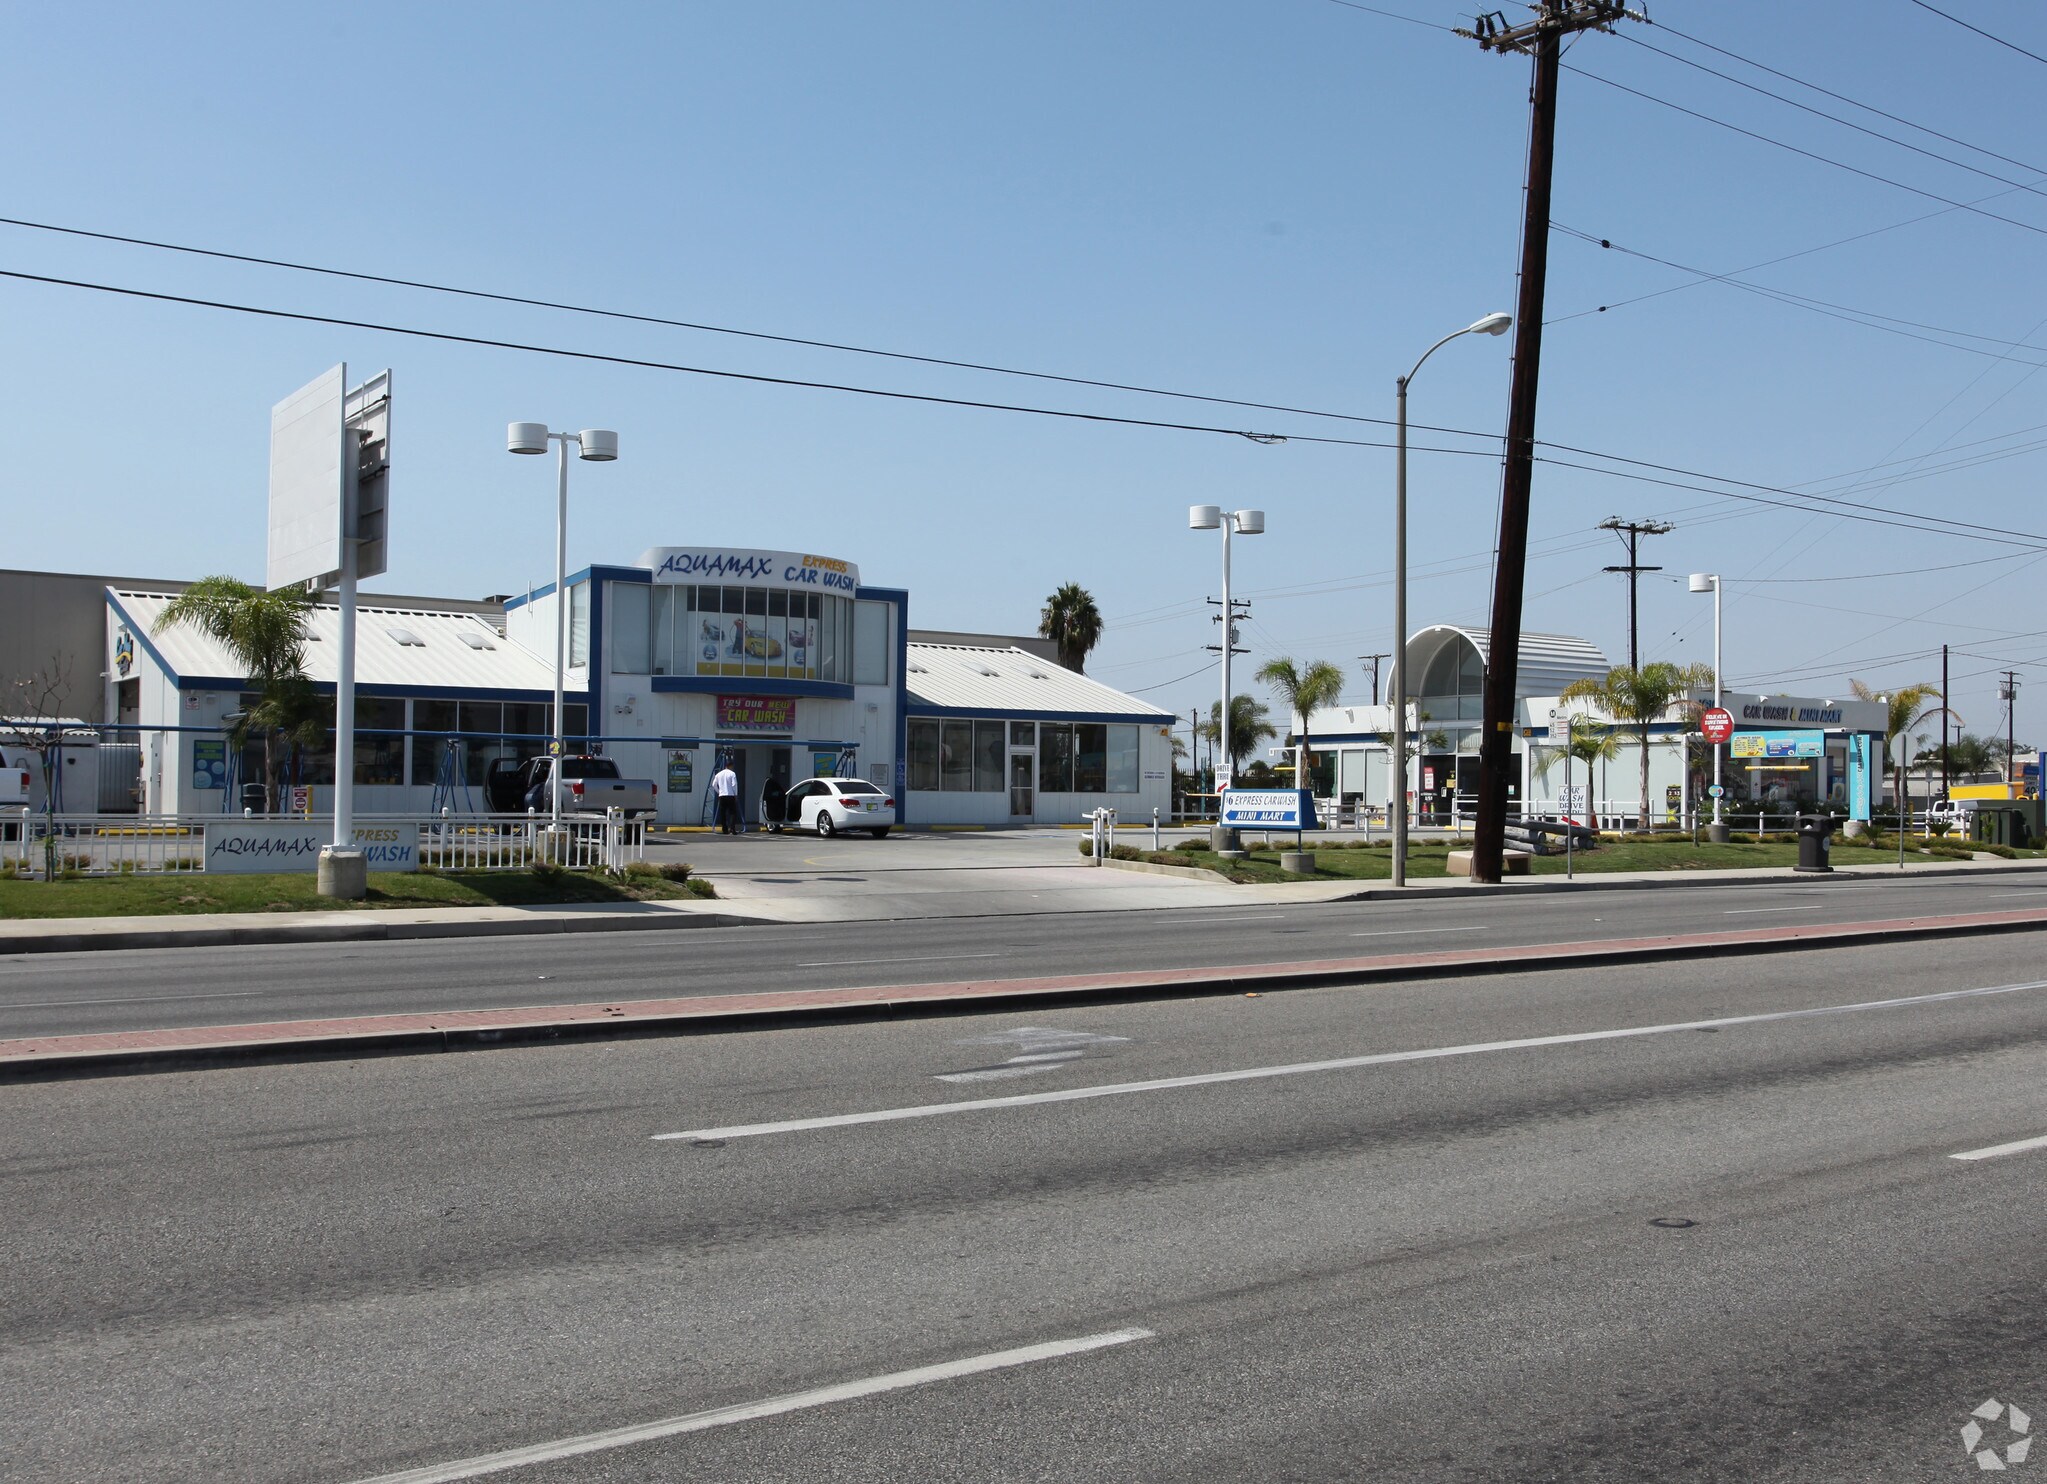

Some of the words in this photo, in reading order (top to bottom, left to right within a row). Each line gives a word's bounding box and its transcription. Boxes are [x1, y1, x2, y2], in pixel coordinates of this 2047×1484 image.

[657, 554, 772, 579] AQUAMAX
[802, 555, 848, 573] EXPRESS
[784, 566, 818, 584] CAR
[823, 572, 854, 592] WASH
[722, 699, 741, 707] TRY
[744, 700, 763, 708] OUR
[727, 709, 750, 722] CAR
[754, 710, 786, 723] WASH
[1743, 705, 1761, 719] CAR
[1763, 706, 1789, 720] WASH
[2025, 786, 2036, 795] 40
[1235, 795, 1263, 806] EXPRESS
[1235, 811, 1257, 820] MINI
[1260, 811, 1286, 820] MART
[351, 829, 400, 841] PRESS
[211, 837, 316, 857] AQUAMAX
[363, 845, 411, 862] WASH
